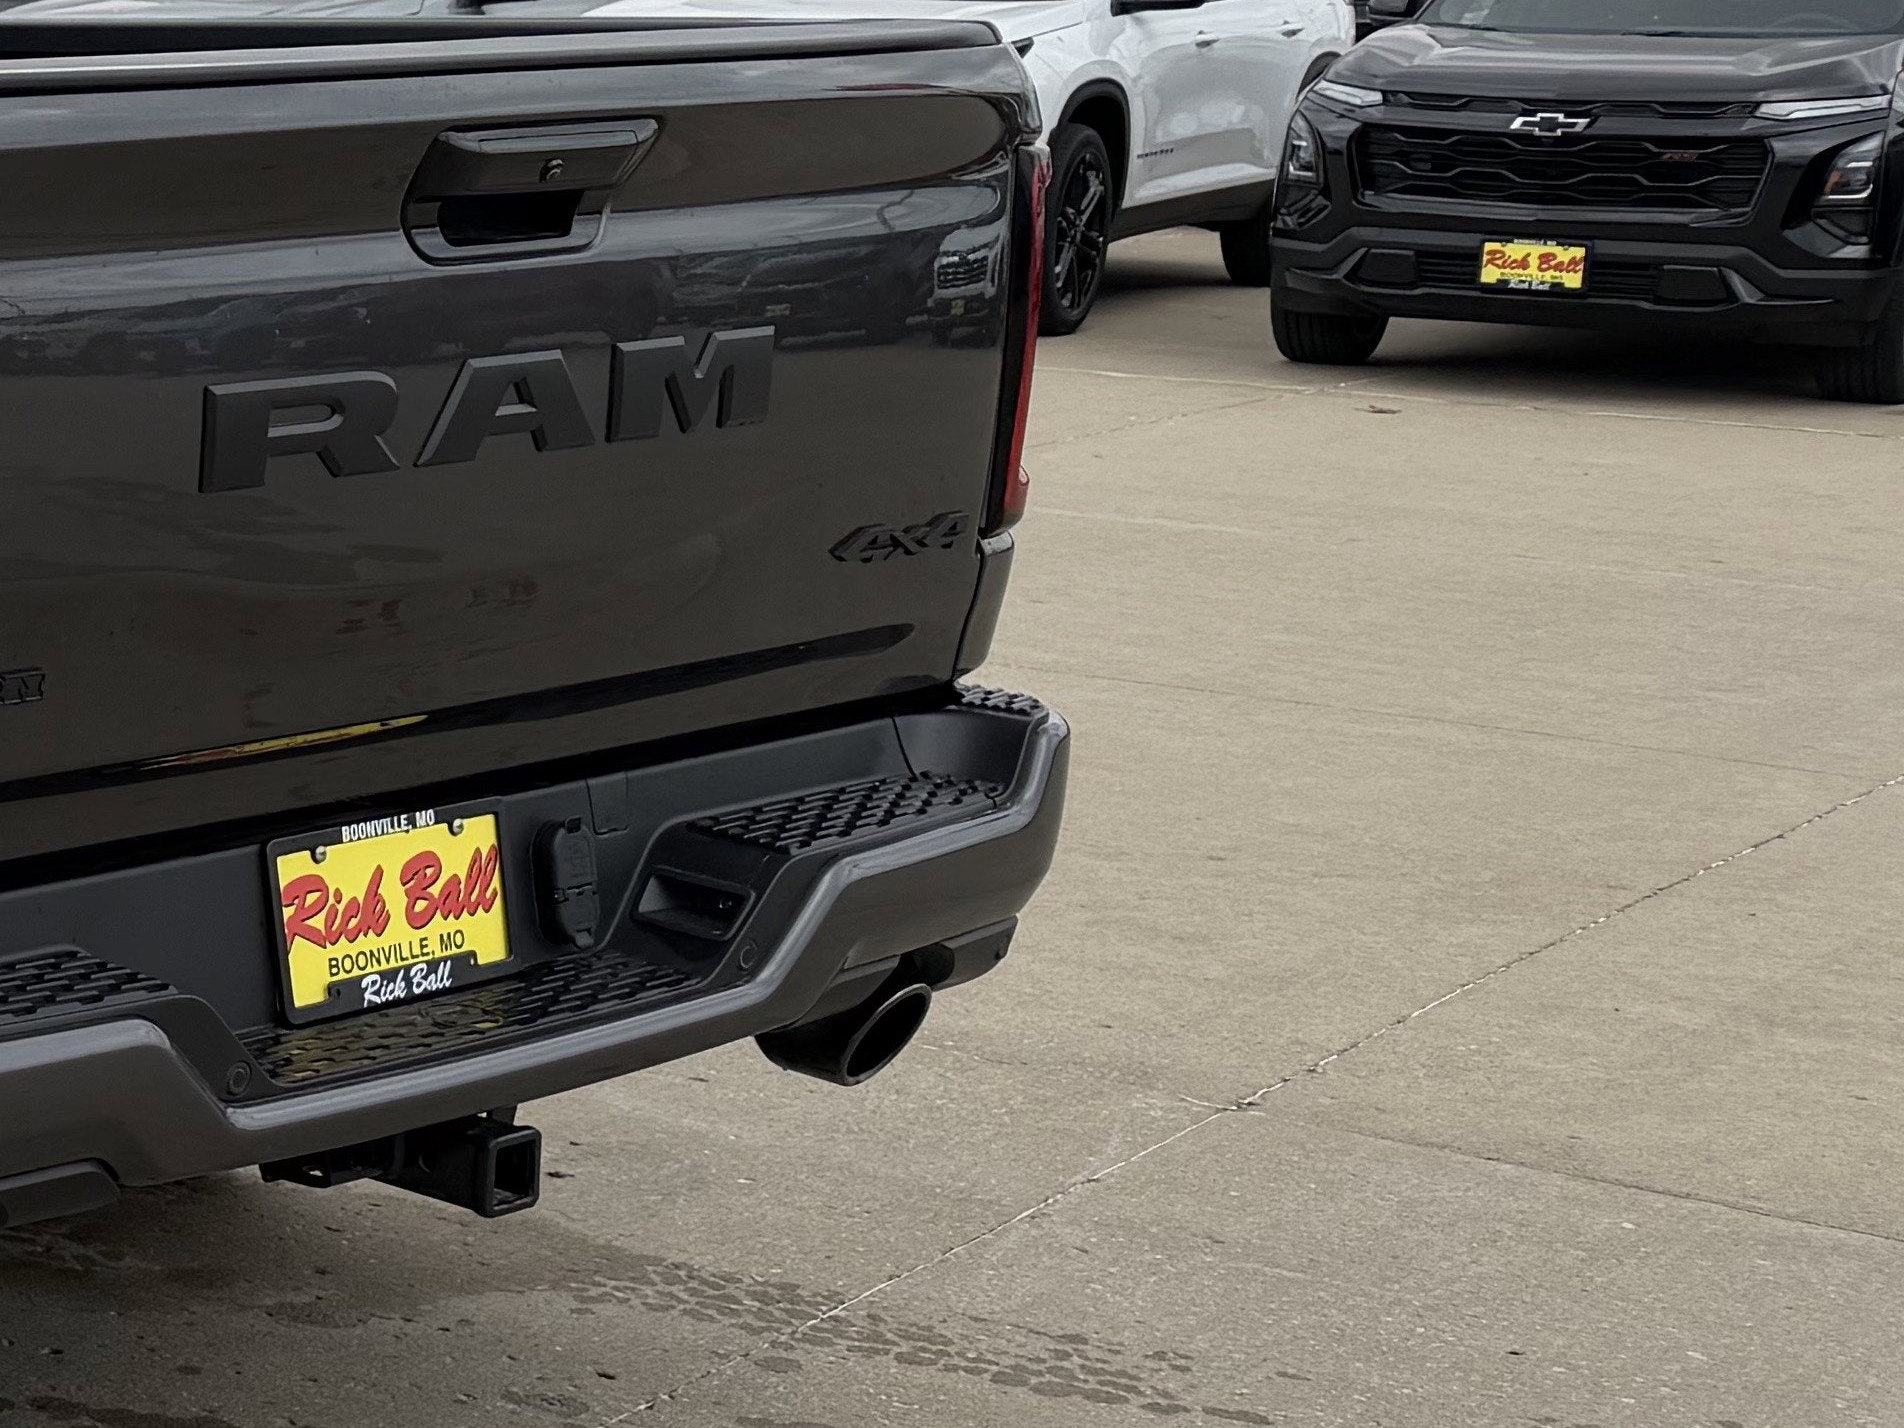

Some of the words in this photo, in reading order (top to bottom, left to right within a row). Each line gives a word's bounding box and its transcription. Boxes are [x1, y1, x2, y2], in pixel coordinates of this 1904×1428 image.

[1483, 249, 1532, 270] Rick
[1537, 252, 1585, 274] Ball
[198, 325, 776, 494] RAM
[341, 814, 412, 843] BOONVILLE,
[415, 808, 435, 827] MO
[281, 863, 392, 955] Rick
[399, 843, 499, 930] Ball
[327, 936, 436, 977] BOONVILLE,
[440, 929, 465, 953] MO
[361, 970, 407, 1007] Rick
[409, 960, 453, 993] Ball
